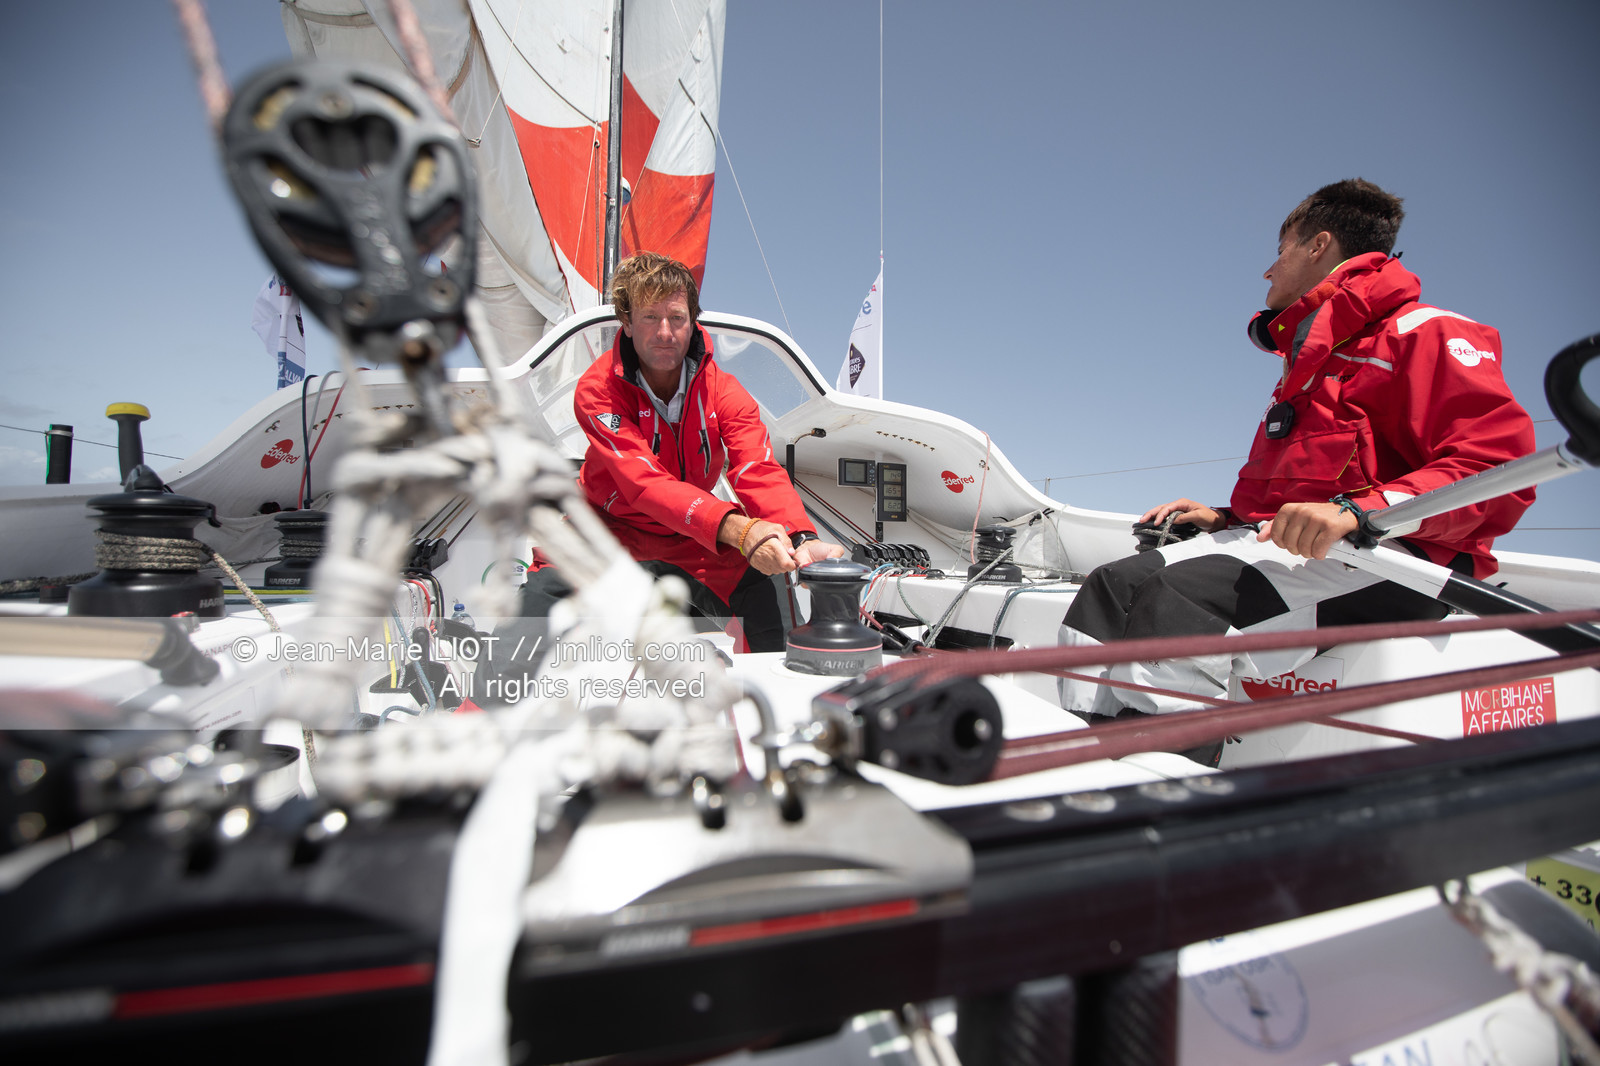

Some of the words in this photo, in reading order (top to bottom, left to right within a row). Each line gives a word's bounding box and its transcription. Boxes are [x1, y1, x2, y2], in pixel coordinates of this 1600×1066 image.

[1447, 345, 1496, 361] Edenred
[265, 444, 301, 464] Edenred
[269, 577, 301, 585] HARKEN
[1467, 705, 1545, 736] AFFAIRES
